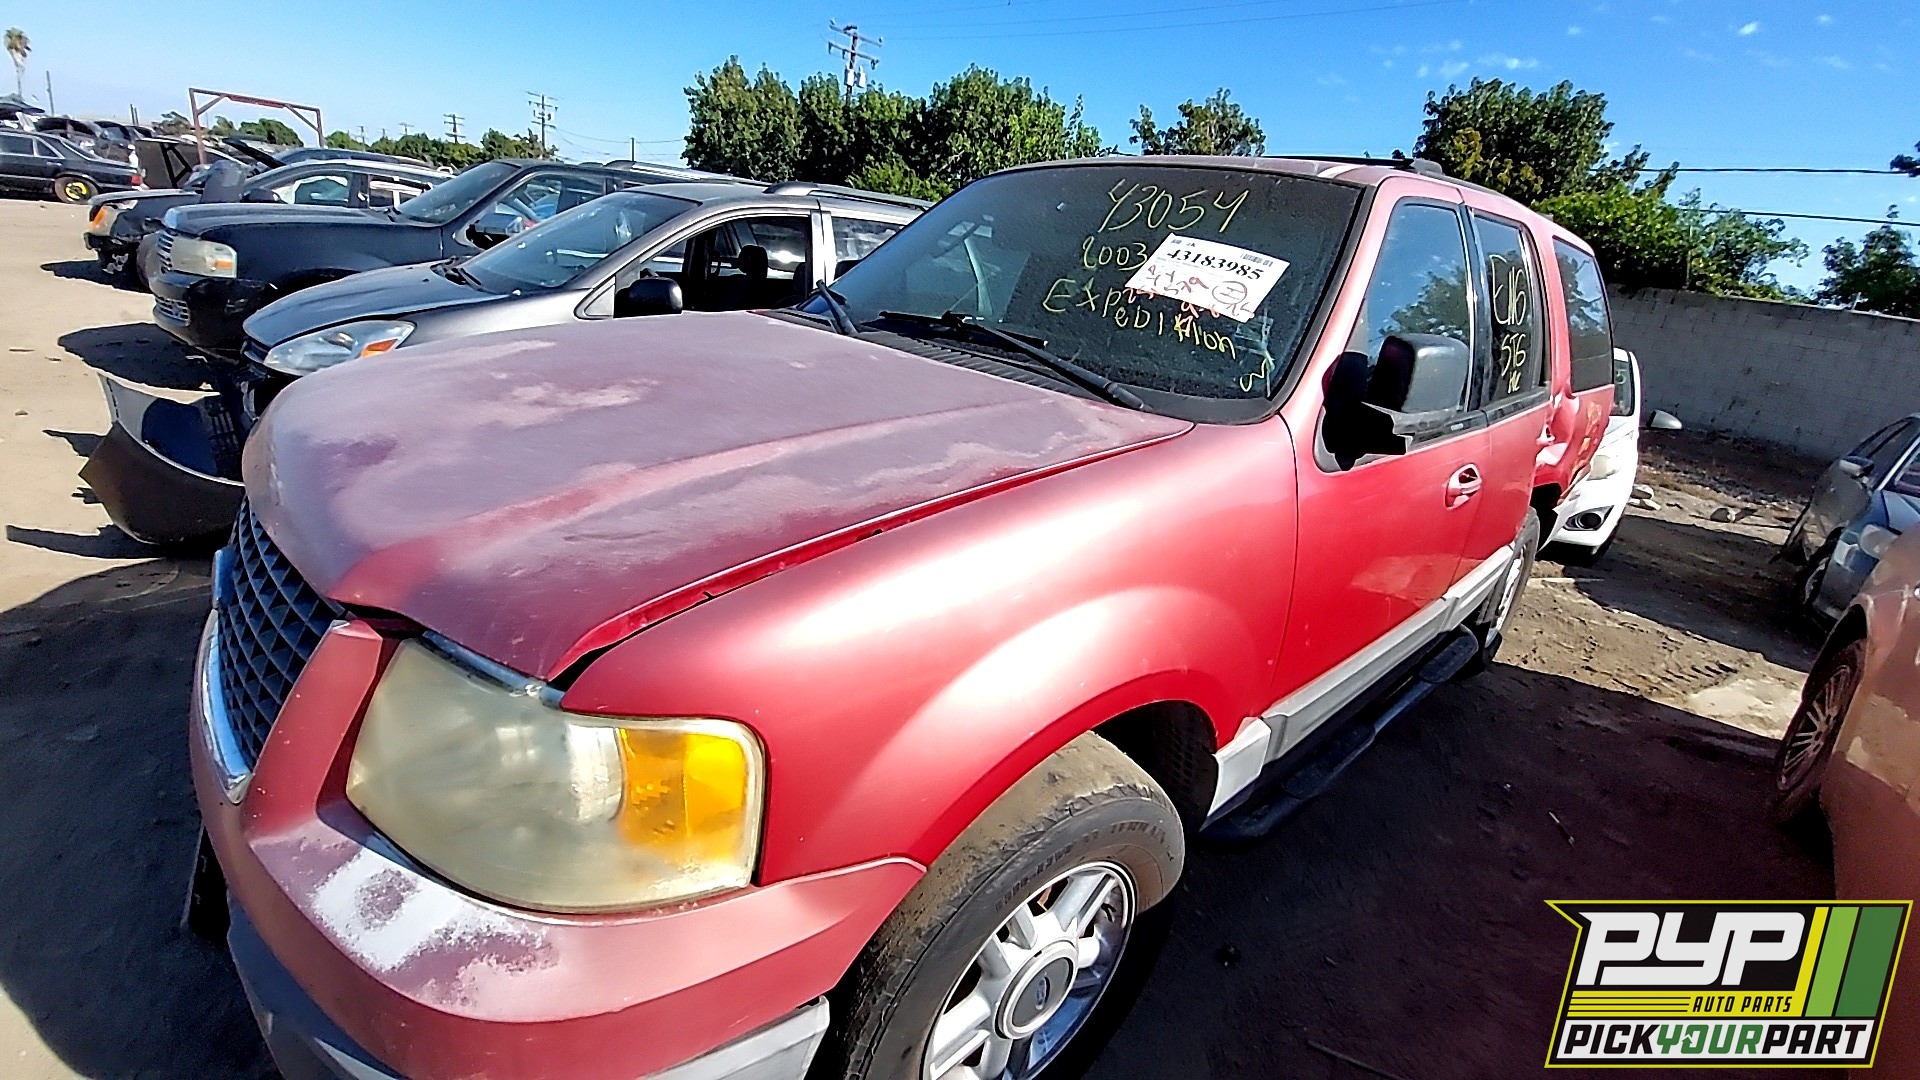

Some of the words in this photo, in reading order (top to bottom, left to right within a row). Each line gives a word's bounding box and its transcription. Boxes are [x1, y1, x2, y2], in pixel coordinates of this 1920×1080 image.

[1097, 179, 1250, 233] 43054
[1081, 236, 1148, 271] 2003
[1167, 249, 1265, 280] 43183985
